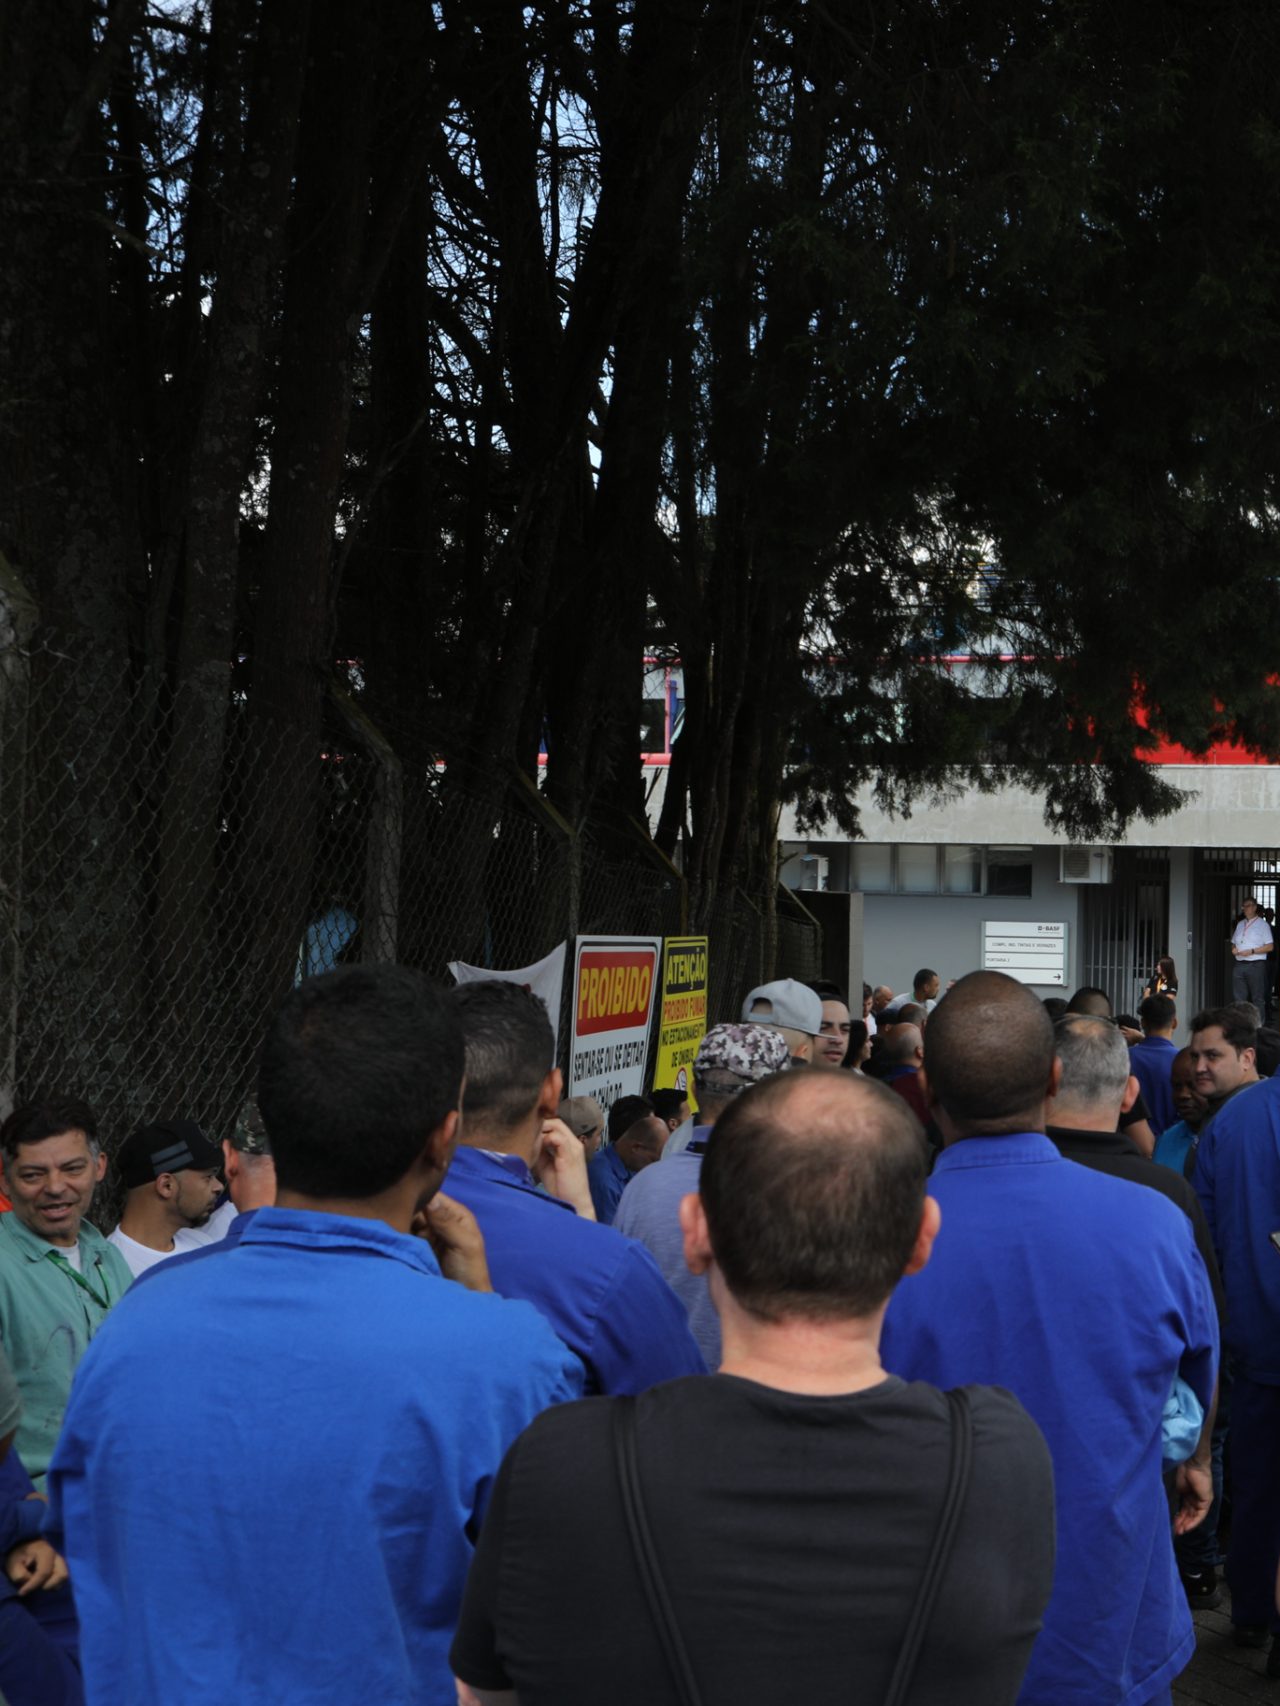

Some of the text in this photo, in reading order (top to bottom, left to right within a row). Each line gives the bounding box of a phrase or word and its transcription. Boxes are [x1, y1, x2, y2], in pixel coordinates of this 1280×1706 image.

[667, 947, 706, 990] ATENÇÃO
[578, 966, 650, 1019] PROIBIDO
[664, 998, 689, 1023] PROIBIDO
[614, 1044, 623, 1071] SE
[622, 1040, 645, 1069] DEITAR
